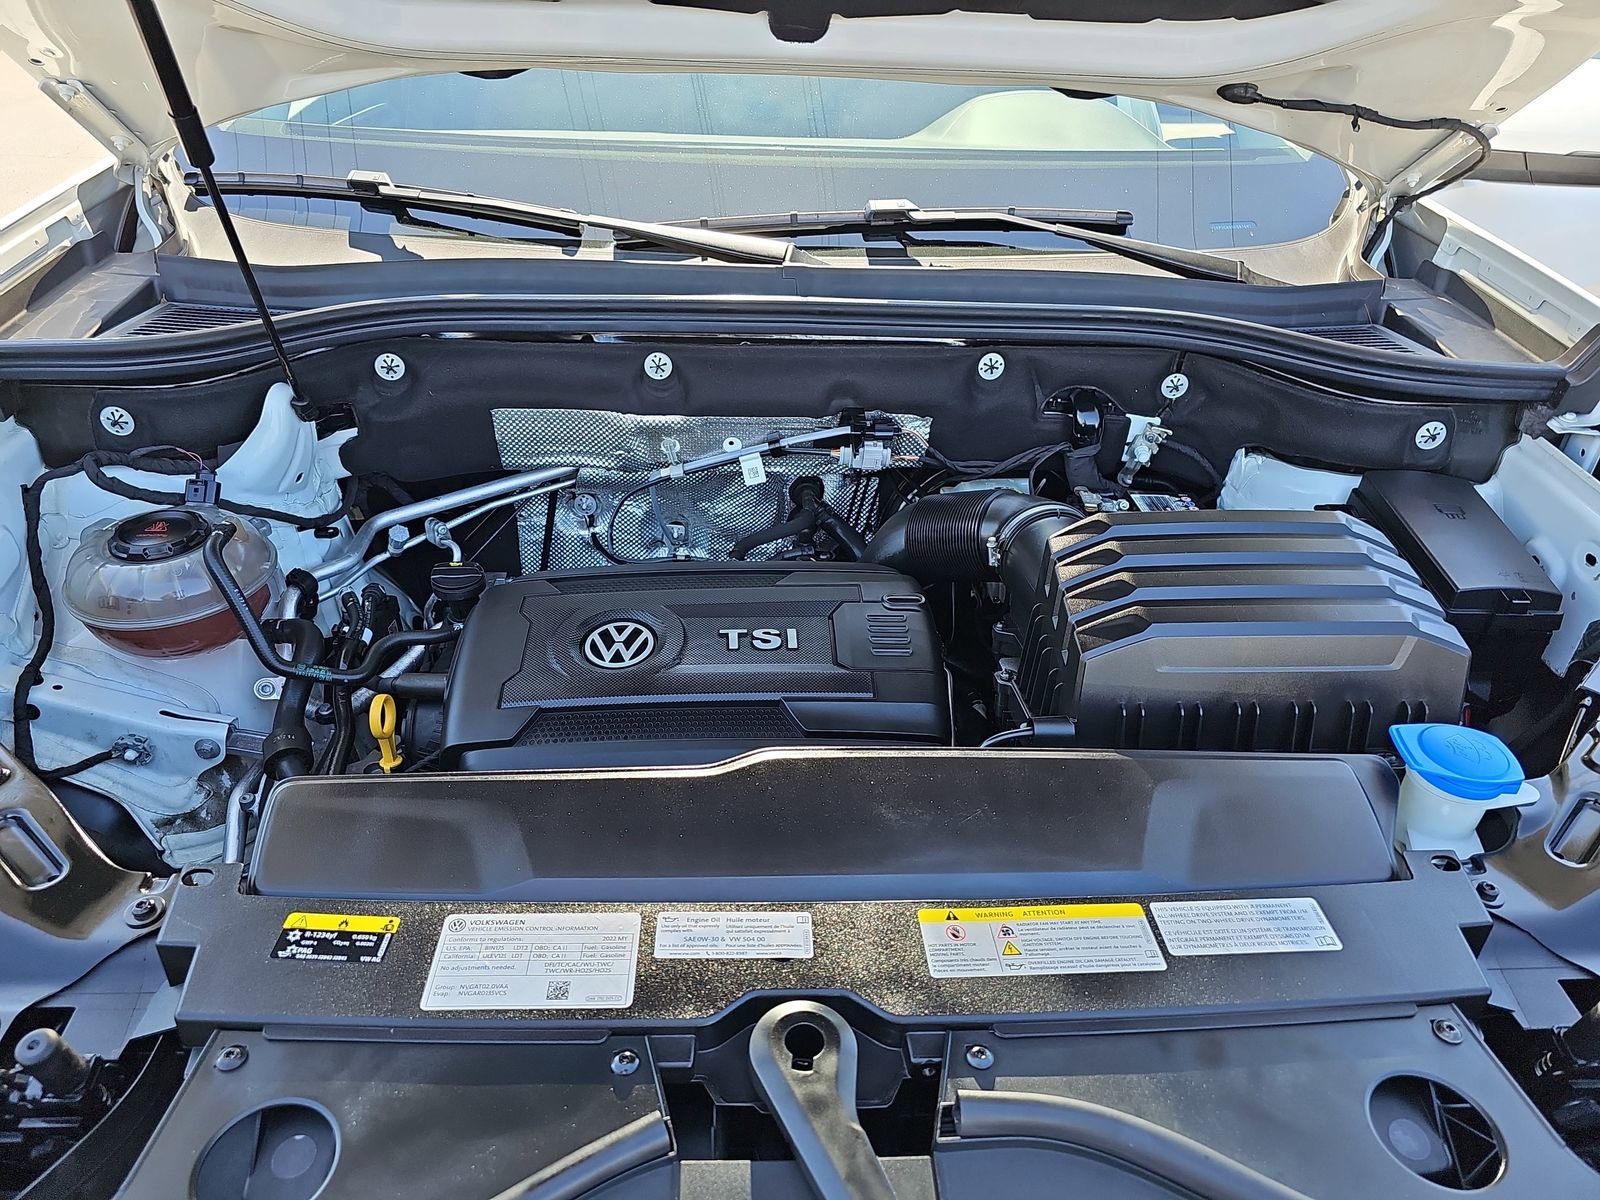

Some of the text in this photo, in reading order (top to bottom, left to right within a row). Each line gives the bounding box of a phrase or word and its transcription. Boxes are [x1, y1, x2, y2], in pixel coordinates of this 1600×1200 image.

[720, 628, 797, 650] TSI
[1023, 909, 1066, 917] ATTENTION
[305, 931, 338, 940] R-1234yf
